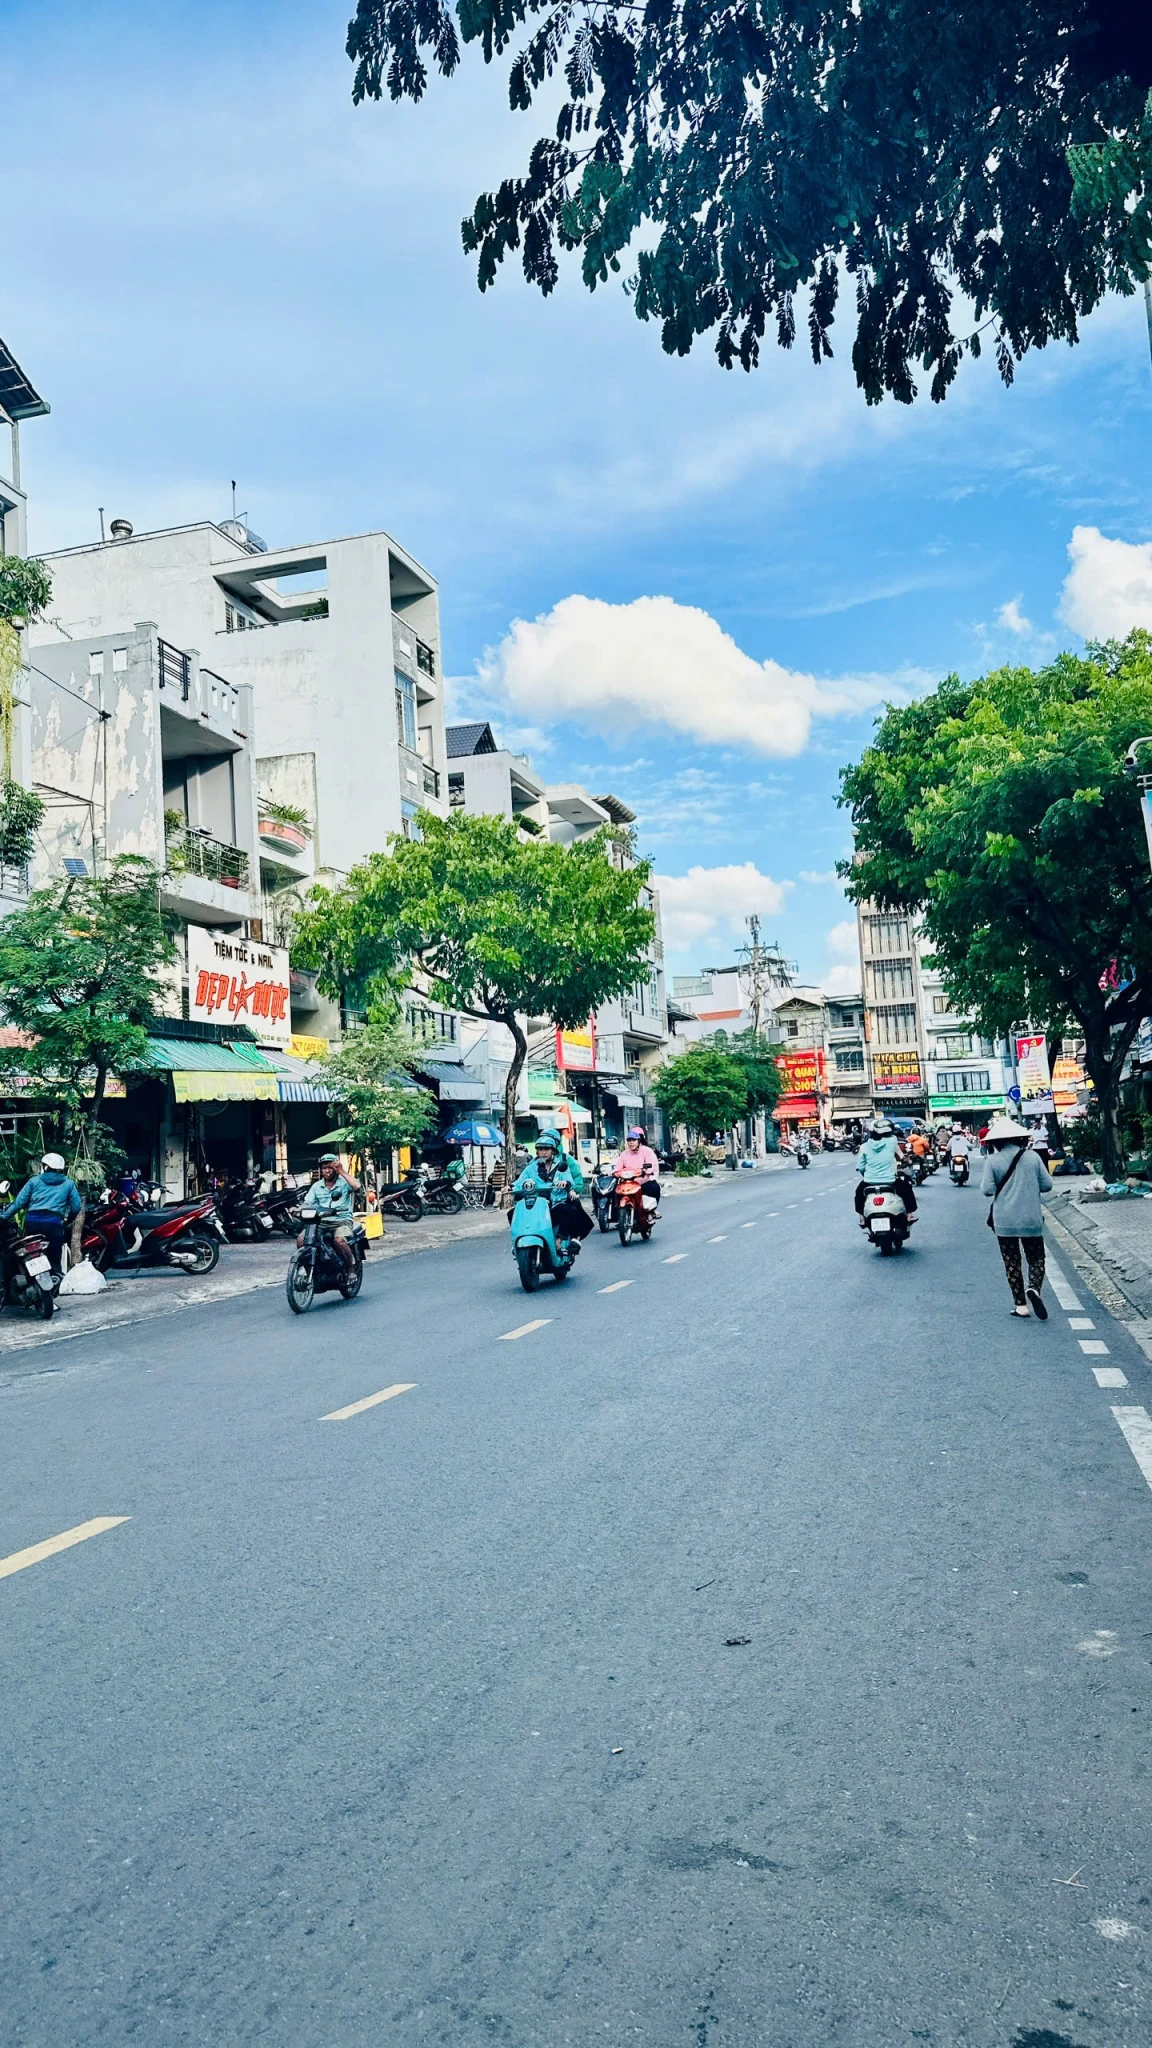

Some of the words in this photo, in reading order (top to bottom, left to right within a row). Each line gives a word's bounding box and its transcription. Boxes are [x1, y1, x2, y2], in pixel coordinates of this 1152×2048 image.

[214, 940, 233, 960] TIỆM
[234, 945, 248, 963] TÓC
[251, 954, 255, 964] &
[258, 953, 274, 969] NAIL
[195, 970, 229, 1015] ĐẸP
